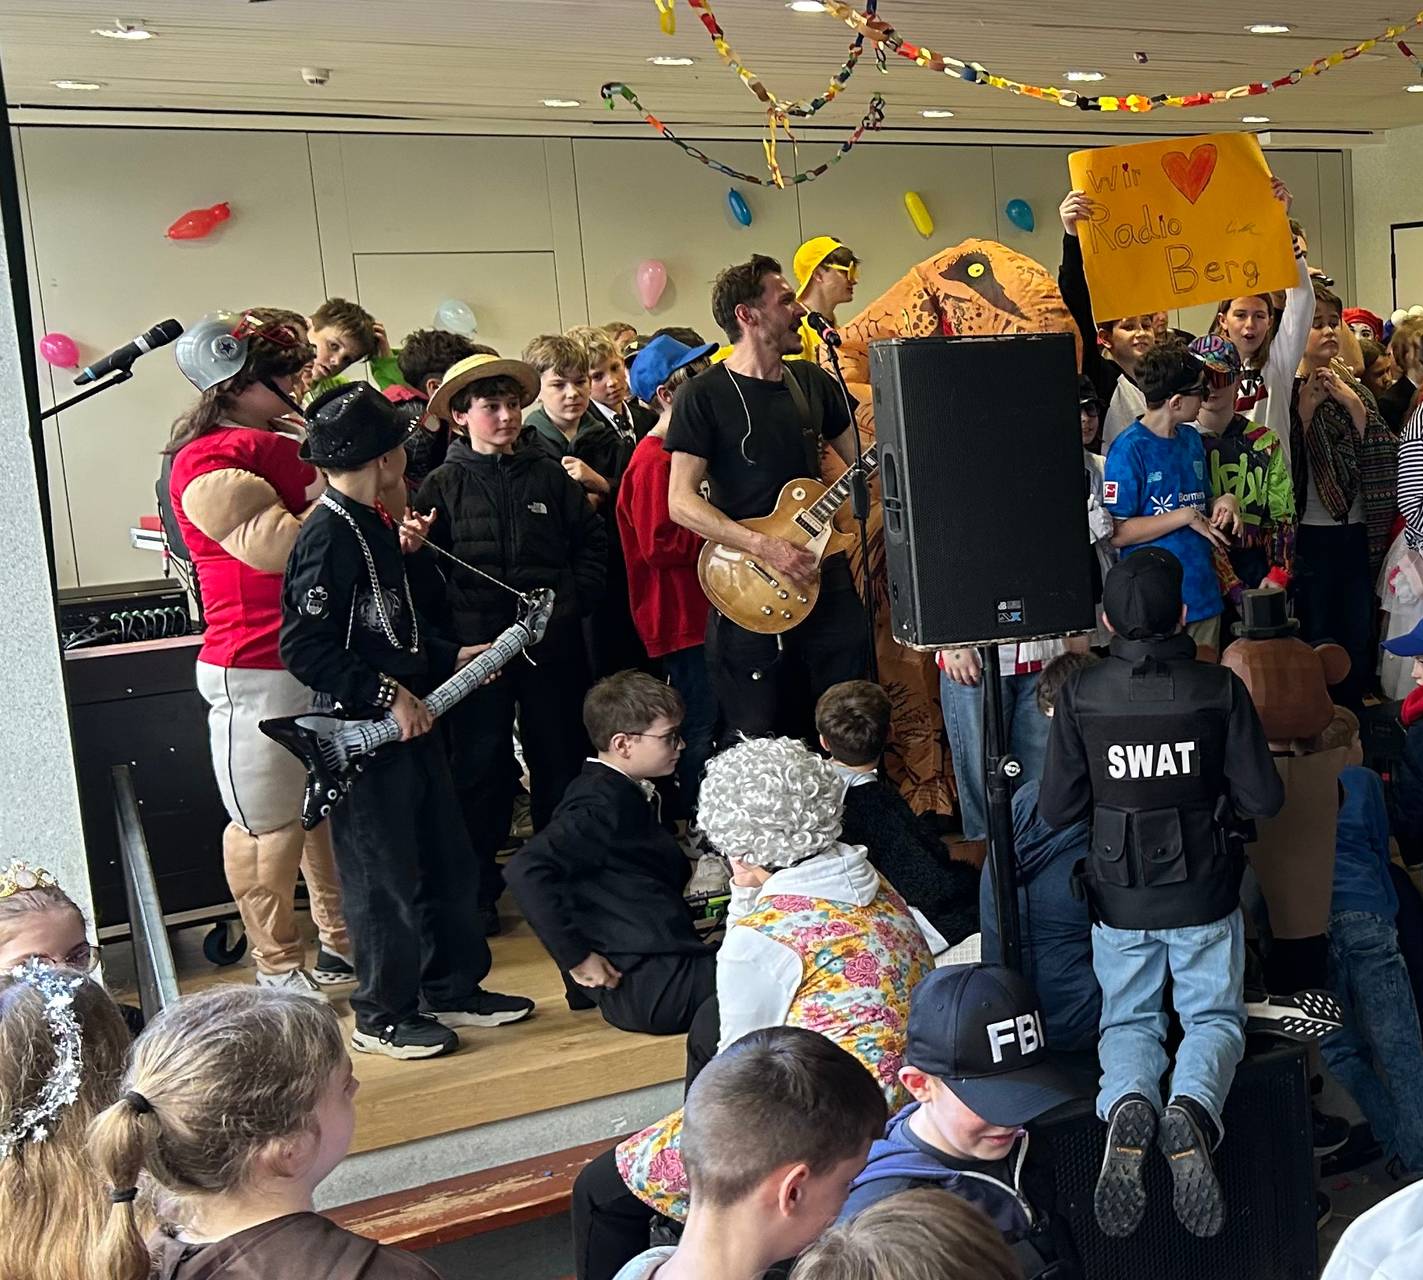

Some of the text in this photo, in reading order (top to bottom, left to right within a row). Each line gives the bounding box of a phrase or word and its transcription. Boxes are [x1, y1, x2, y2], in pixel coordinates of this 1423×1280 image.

[1086, 162, 1141, 193] Wir
[1086, 203, 1182, 254] Radio
[1163, 244, 1260, 294] Berg
[1108, 741, 1195, 779] SWAT
[987, 1010, 1045, 1063] FBI
